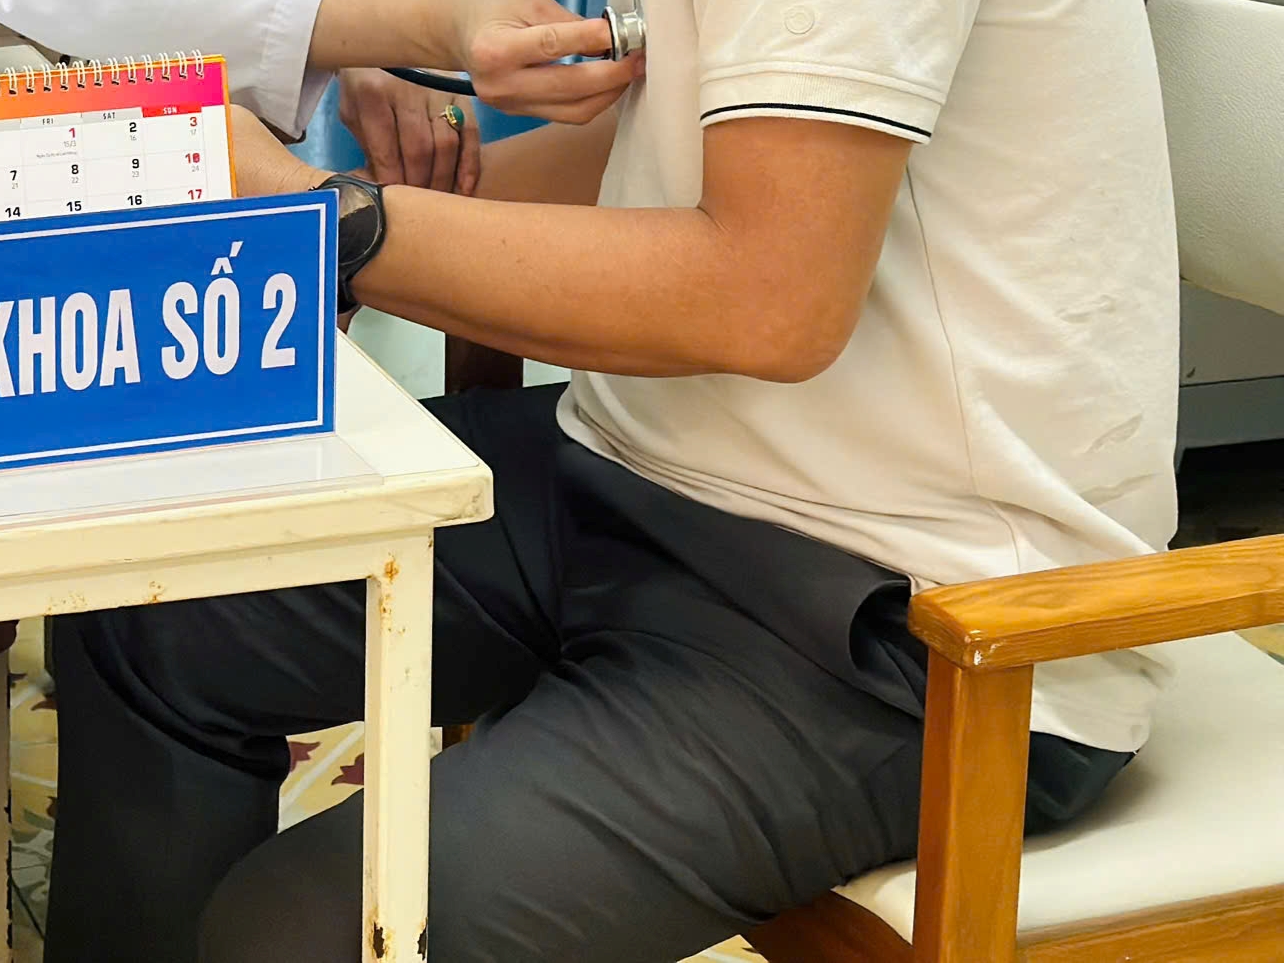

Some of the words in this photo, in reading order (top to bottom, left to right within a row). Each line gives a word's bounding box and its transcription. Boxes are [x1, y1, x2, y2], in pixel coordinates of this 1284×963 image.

[68, 127, 76, 138] 1
[129, 122, 137, 133] 2
[189, 116, 197, 127] 3
[103, 112, 116, 120] SAT
[10, 170, 17, 181] 7
[71, 164, 79, 175] 8
[131, 158, 140, 169] 9
[5, 207, 21, 218] 14
[66, 201, 82, 212] 15
[127, 195, 143, 206] 16
[188, 189, 202, 200] 17
[161, 240, 244, 381] SỐ
[261, 273, 298, 371] 2
